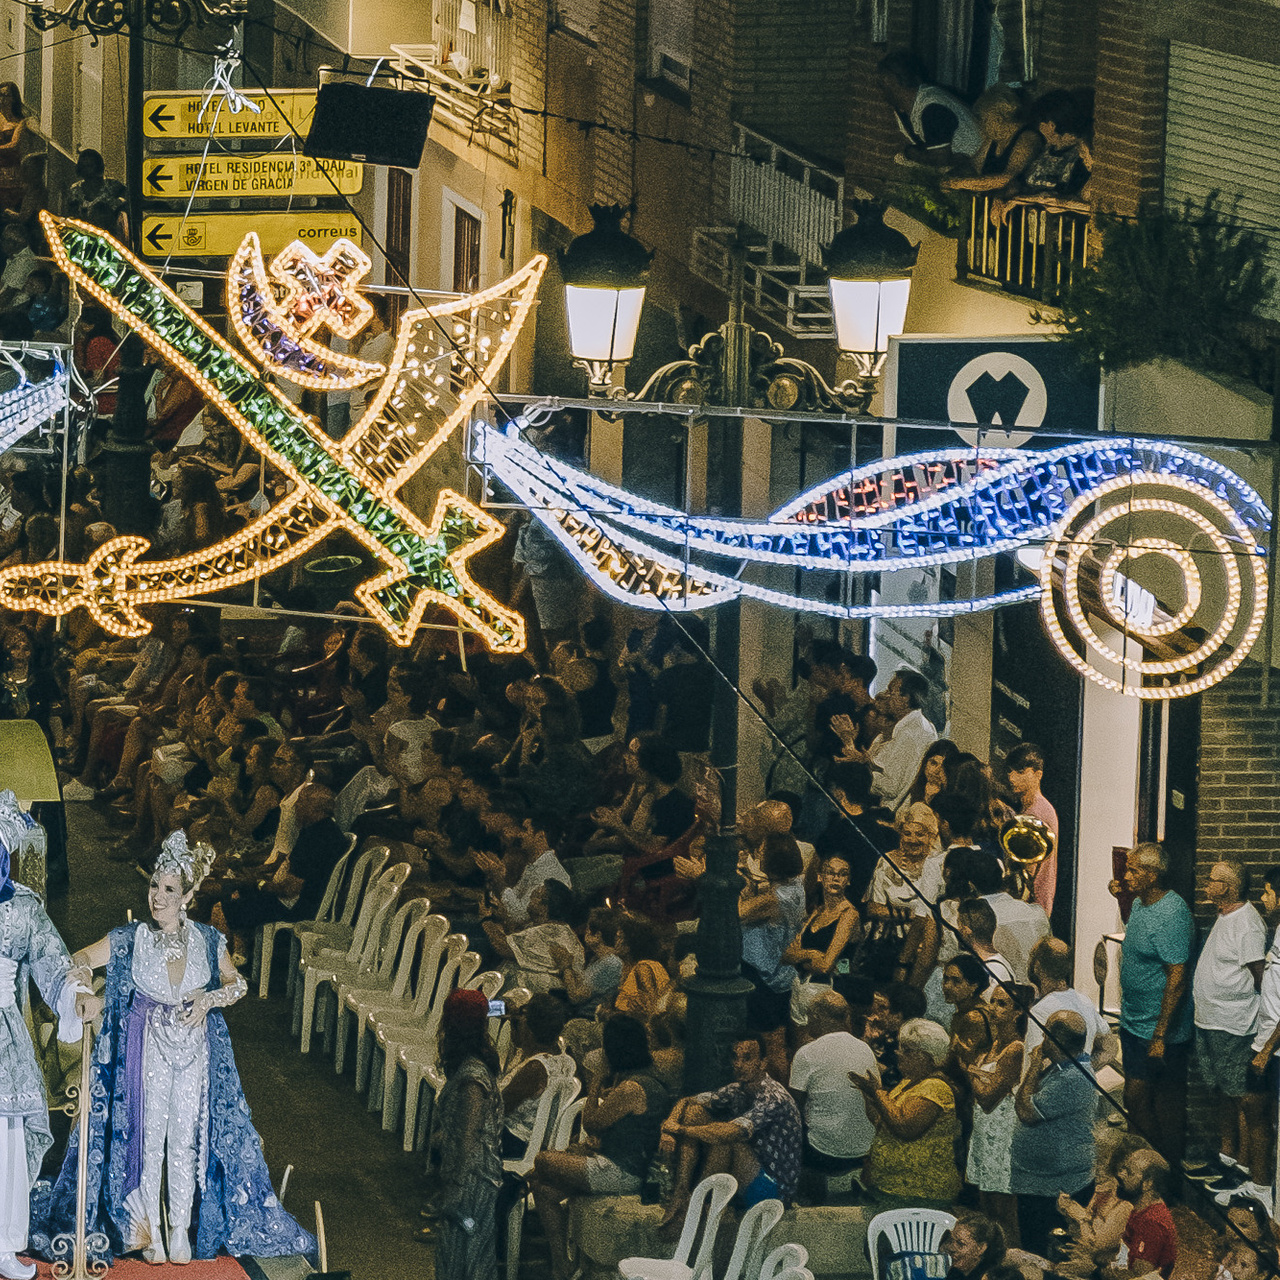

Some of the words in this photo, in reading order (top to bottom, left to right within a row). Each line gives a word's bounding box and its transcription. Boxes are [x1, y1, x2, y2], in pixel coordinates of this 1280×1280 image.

[187, 121, 225, 134] HOTEL
[228, 121, 280, 134] LEVANTE
[185, 161, 223, 175] HOTEL
[226, 160, 296, 174] RESIDENCIA
[186, 178, 228, 192] VIRGEN
[232, 178, 247, 191] DE
[251, 177, 294, 191] GRACIA
[297, 225, 358, 239] correus
